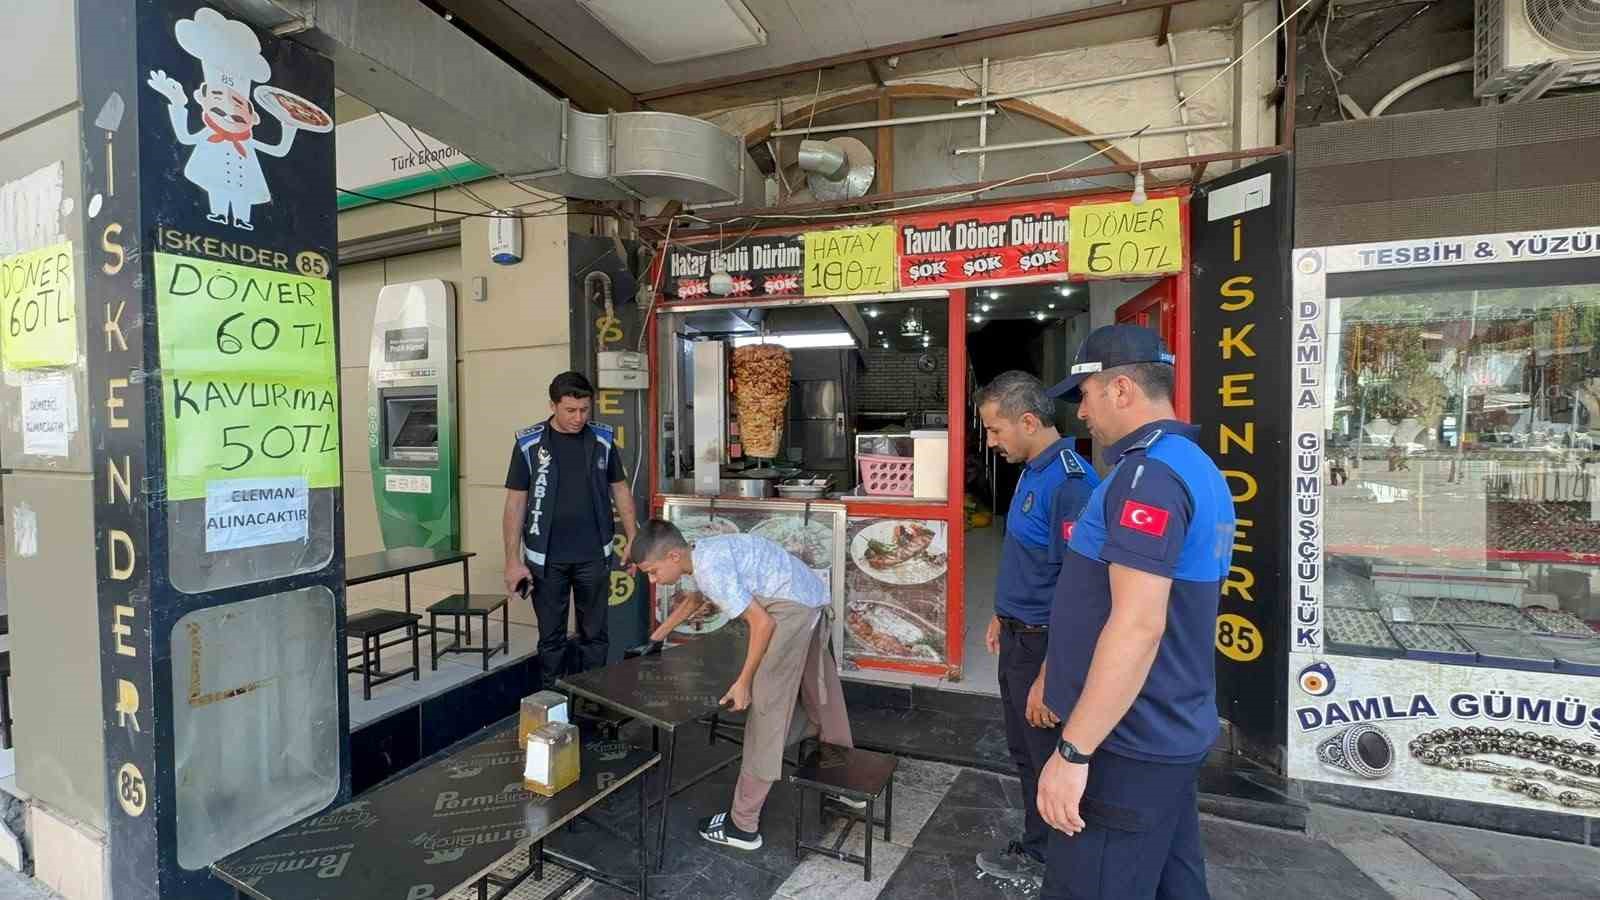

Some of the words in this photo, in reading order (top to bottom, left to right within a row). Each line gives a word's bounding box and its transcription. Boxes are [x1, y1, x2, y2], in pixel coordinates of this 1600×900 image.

[391, 152, 415, 171] Türk
[904, 224, 951, 255] Tavuk
[955, 222, 1006, 251] Döner
[1011, 215, 1069, 246] Dürüm
[1082, 207, 1165, 239] DÖNER
[157, 223, 289, 269] İSKENDER
[300, 254, 324, 275] 85
[671, 252, 708, 278] Hatay
[752, 243, 800, 270] Dürüm
[813, 232, 881, 260] HATAY
[1019, 249, 1061, 271] ŞOK
[1358, 242, 1463, 266] TESBİH
[1474, 241, 1495, 259] &
[1507, 231, 1600, 255] YÜZÜ
[2, 252, 71, 299] DÖNER
[908, 260, 949, 281] ŞOK
[963, 255, 1003, 277] ŞOK
[169, 263, 317, 306] DÖNER
[764, 275, 800, 295] ŞOK
[216, 312, 281, 355] 60
[293, 323, 329, 349] TL
[1297, 301, 1320, 408] DAMLA
[172, 378, 336, 420] KAVURMA
[1218, 219, 1259, 602] İSKENDER
[231, 487, 296, 503] ELEMAN
[529, 462, 551, 536] ZABITA
[207, 508, 307, 530] ALINACAKTIR
[1296, 432, 1320, 648] GÜMÜŞÇÜLÜK
[1217, 620, 1255, 655] 85
[1296, 694, 1438, 731] DAMLA
[120, 769, 146, 808] 85
